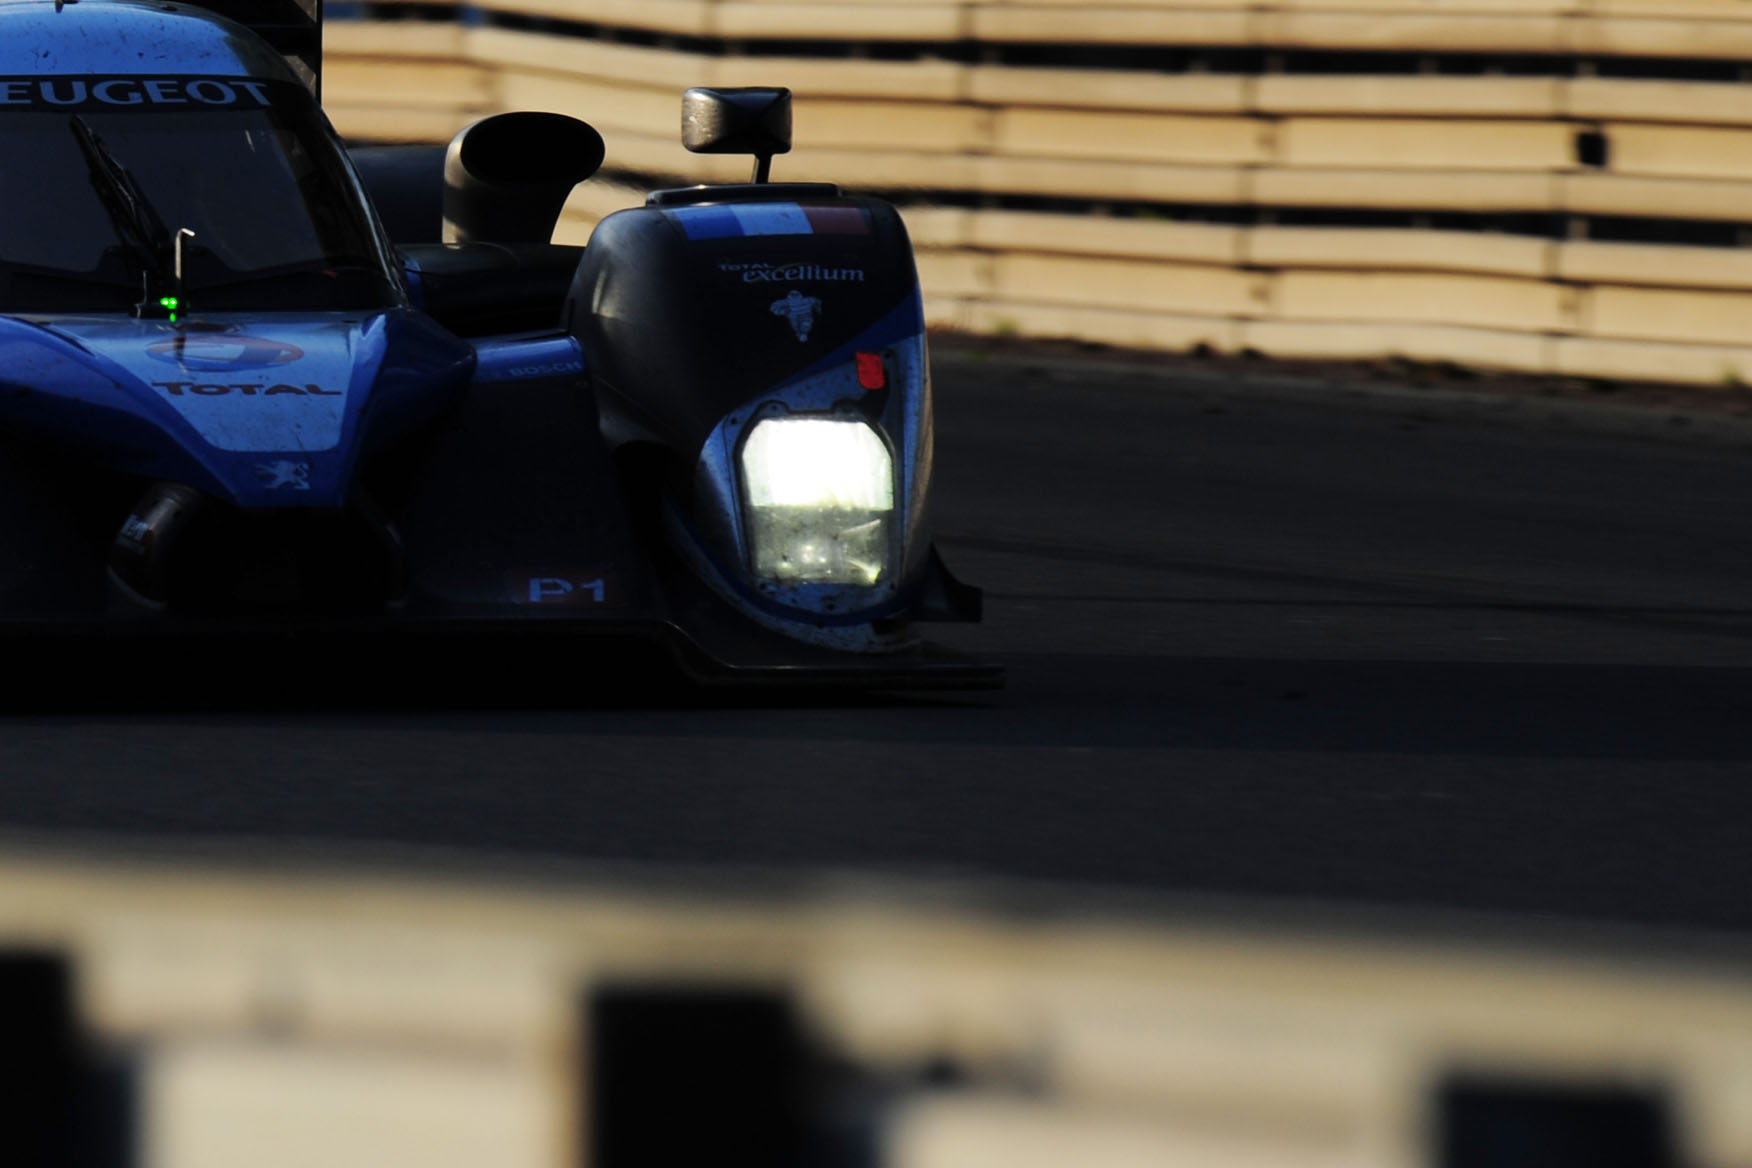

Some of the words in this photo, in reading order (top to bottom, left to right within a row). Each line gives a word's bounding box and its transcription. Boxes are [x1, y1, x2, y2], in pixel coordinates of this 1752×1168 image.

[718, 262, 770, 272] TOTAL
[743, 264, 865, 283] excellium
[151, 382, 342, 396] TOTAL
[528, 577, 605, 603] P1
